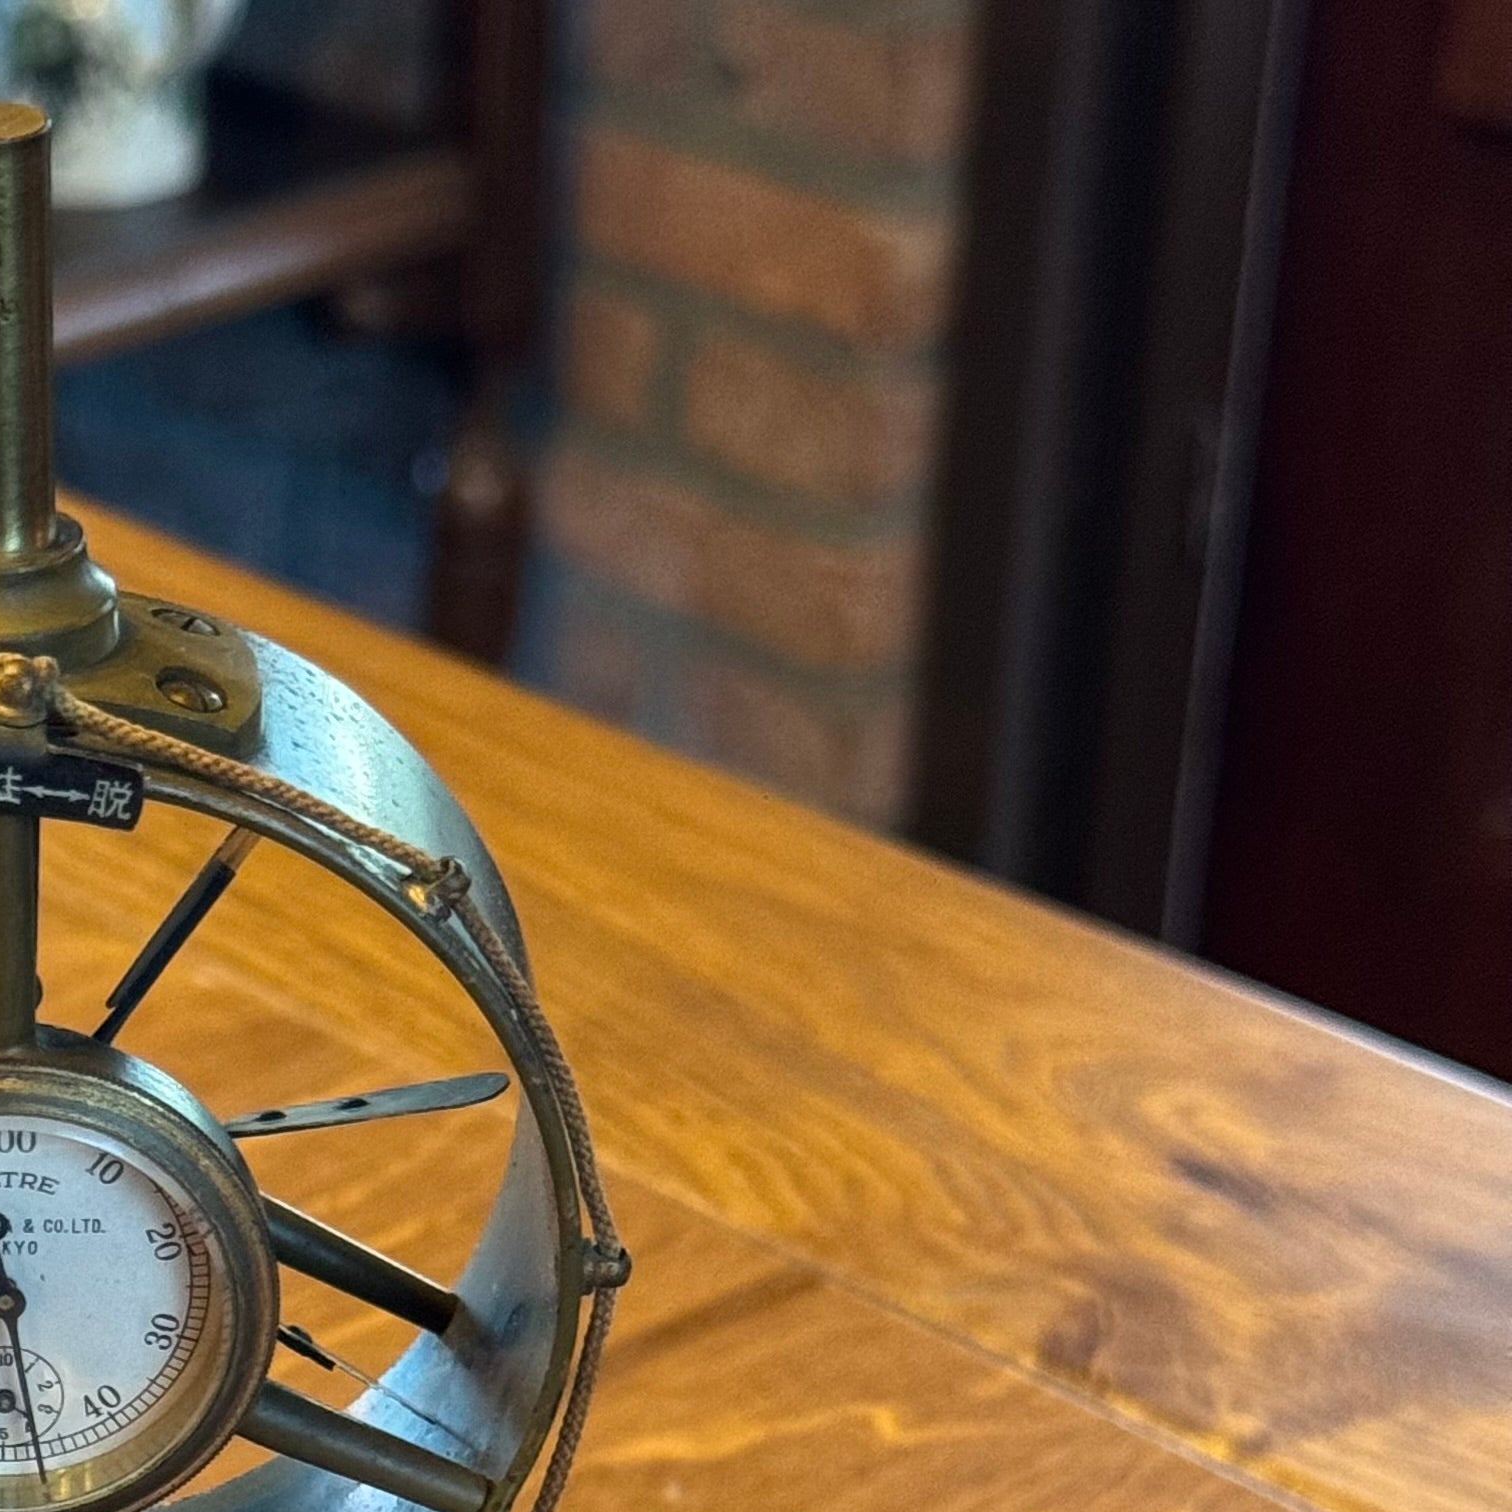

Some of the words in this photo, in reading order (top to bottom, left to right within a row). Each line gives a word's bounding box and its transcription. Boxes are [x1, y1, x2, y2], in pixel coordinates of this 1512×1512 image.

[88, 779, 134, 820] 脱
[85, 1152, 124, 1185] 10
[23, 1218, 35, 1234] &
[43, 1218, 107, 1234] CO.LTD.
[145, 1223, 182, 1261] 20
[144, 1313, 180, 1351] 30
[37, 1380, 54, 1392] 2
[83, 1384, 122, 1419] 40
[37, 1404, 53, 1414] 3
